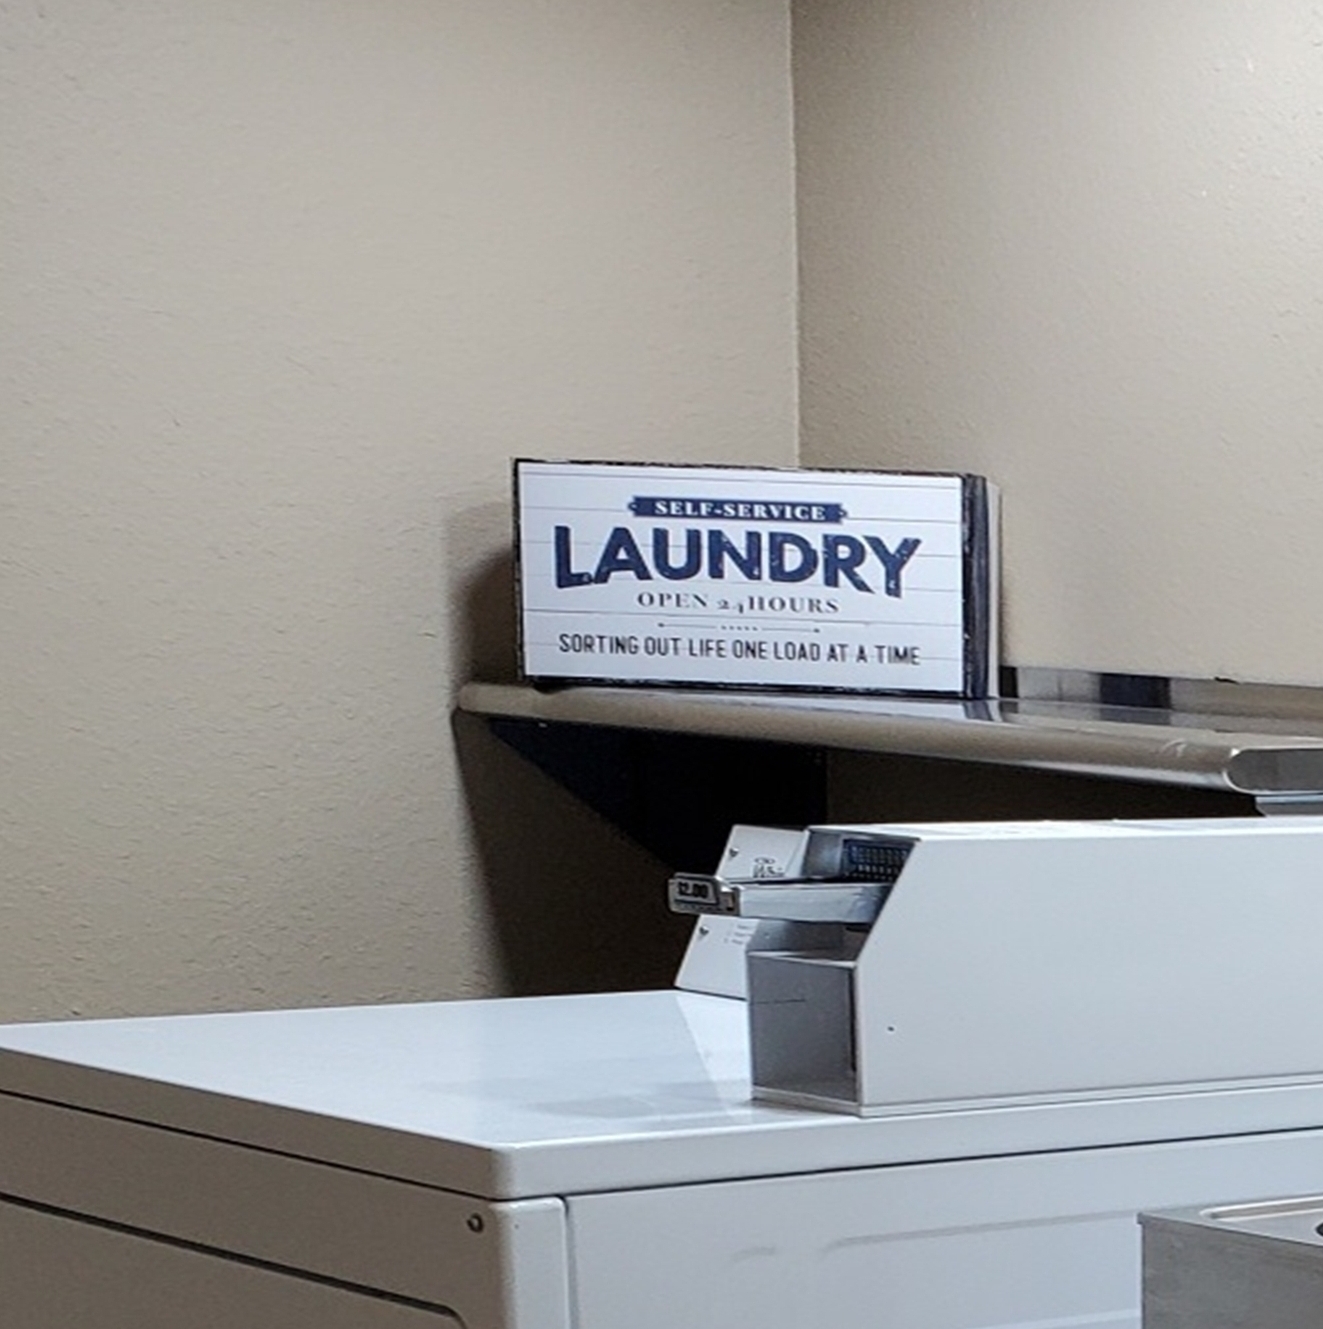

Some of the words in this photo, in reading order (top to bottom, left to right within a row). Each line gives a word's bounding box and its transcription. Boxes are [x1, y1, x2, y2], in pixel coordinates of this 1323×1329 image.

[654, 499, 826, 521] SELF-SERVICE
[554, 524, 922, 598] LAUNDRY
[637, 591, 708, 612] OPEN
[559, 632, 640, 657] SORTING
[644, 636, 679, 658] OUT
[688, 638, 726, 659] LIFE
[734, 639, 769, 661] ONE
[774, 641, 820, 663] LOAD
[827, 644, 851, 664] AT
[856, 644, 869, 664] A
[875, 644, 920, 666] TIME
